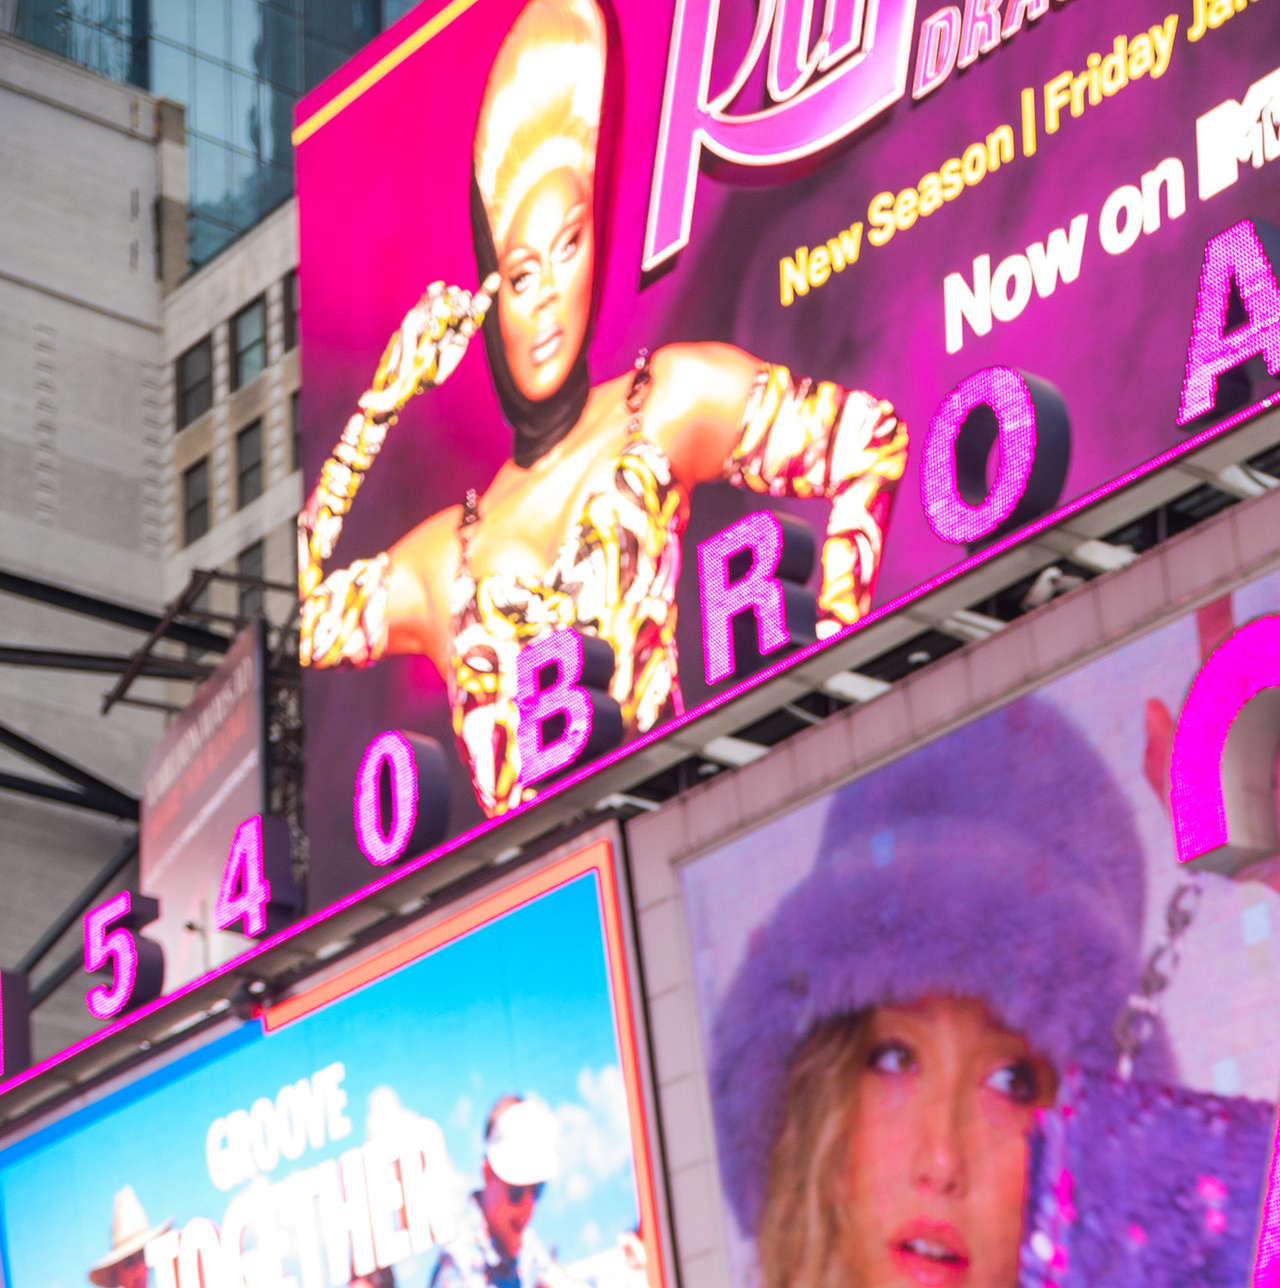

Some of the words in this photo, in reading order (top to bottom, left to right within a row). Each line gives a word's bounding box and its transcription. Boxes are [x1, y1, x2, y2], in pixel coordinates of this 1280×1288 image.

[779, 246, 863, 306] New
[868, 125, 1014, 246] Season
[1044, 14, 1179, 134] Friday
[1187, 0, 1254, 42] Ja
[943, 213, 1088, 354] Now
[1099, 157, 1186, 254] on
[206, 1062, 351, 1191] GROOVE
